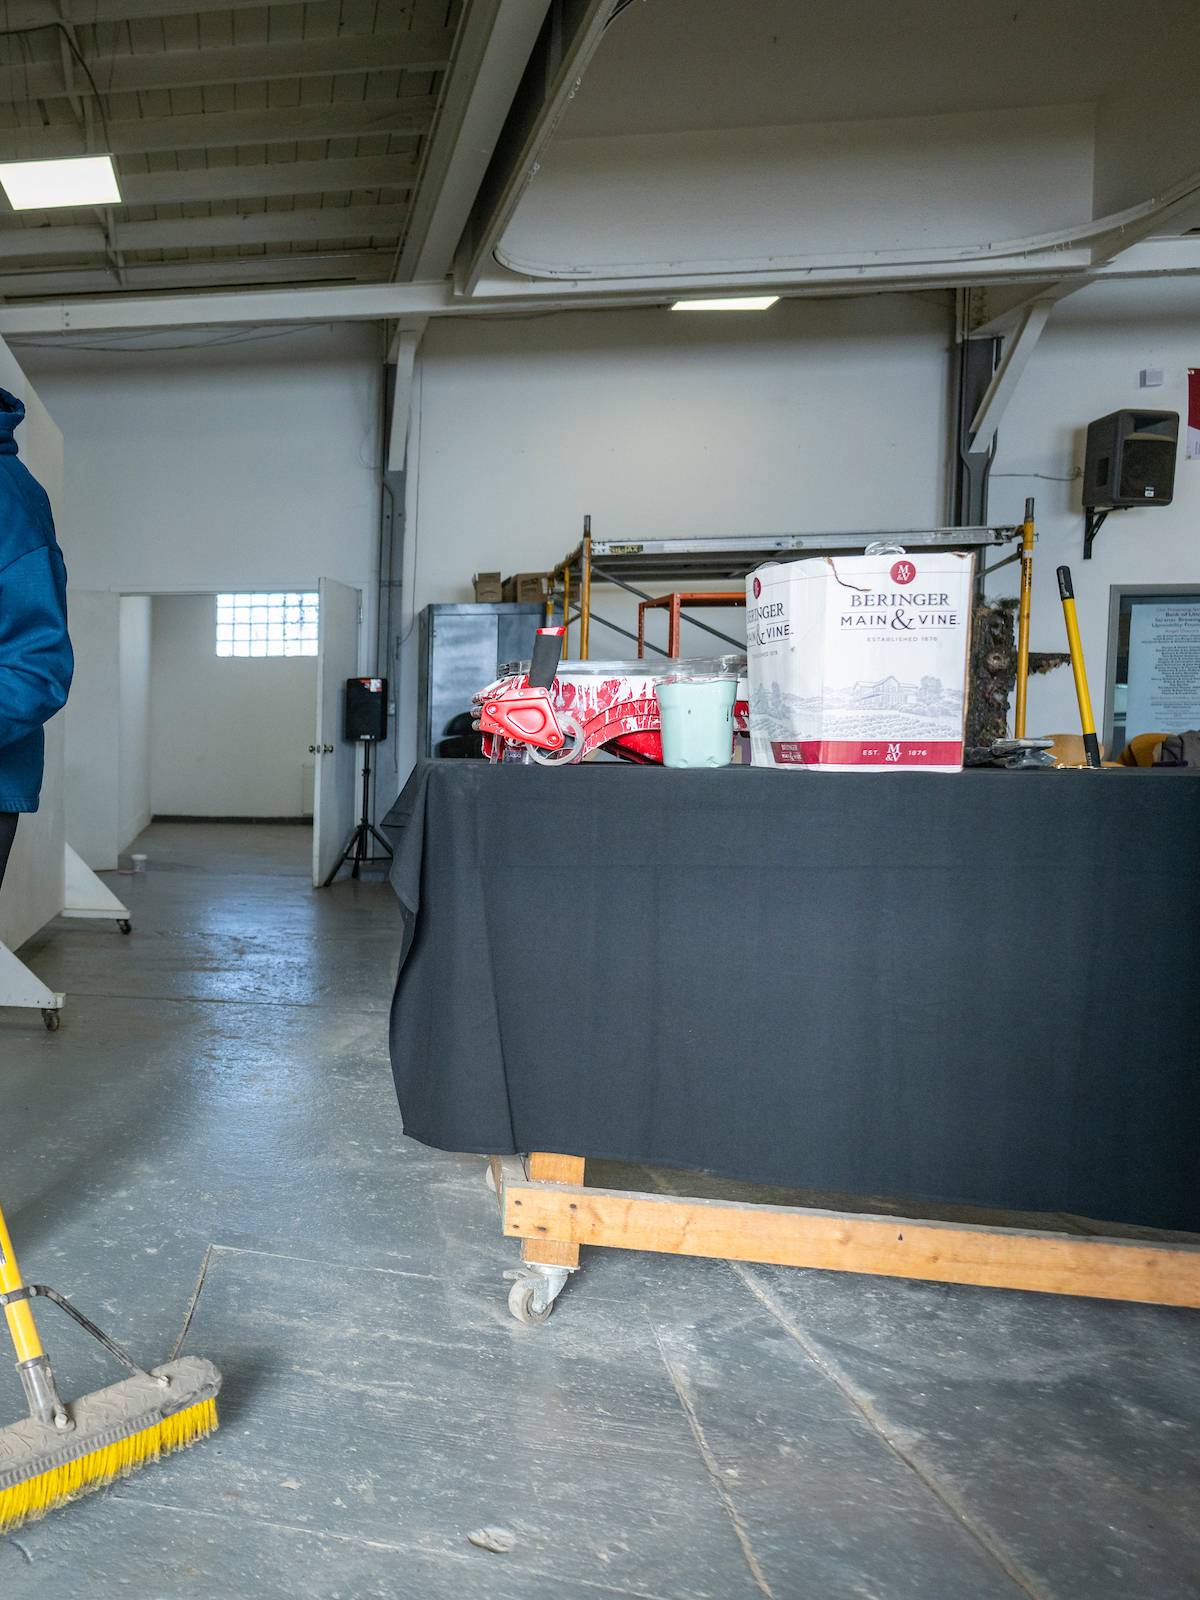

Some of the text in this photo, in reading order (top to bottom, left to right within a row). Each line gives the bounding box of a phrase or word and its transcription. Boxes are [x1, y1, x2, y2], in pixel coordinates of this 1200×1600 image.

[850, 593, 950, 607] BERINGER
[747, 602, 784, 624] ERINGER
[841, 608, 957, 630] MAIN & VINE
[766, 624, 790, 639] VINE
[907, 749, 928, 757] 1876
